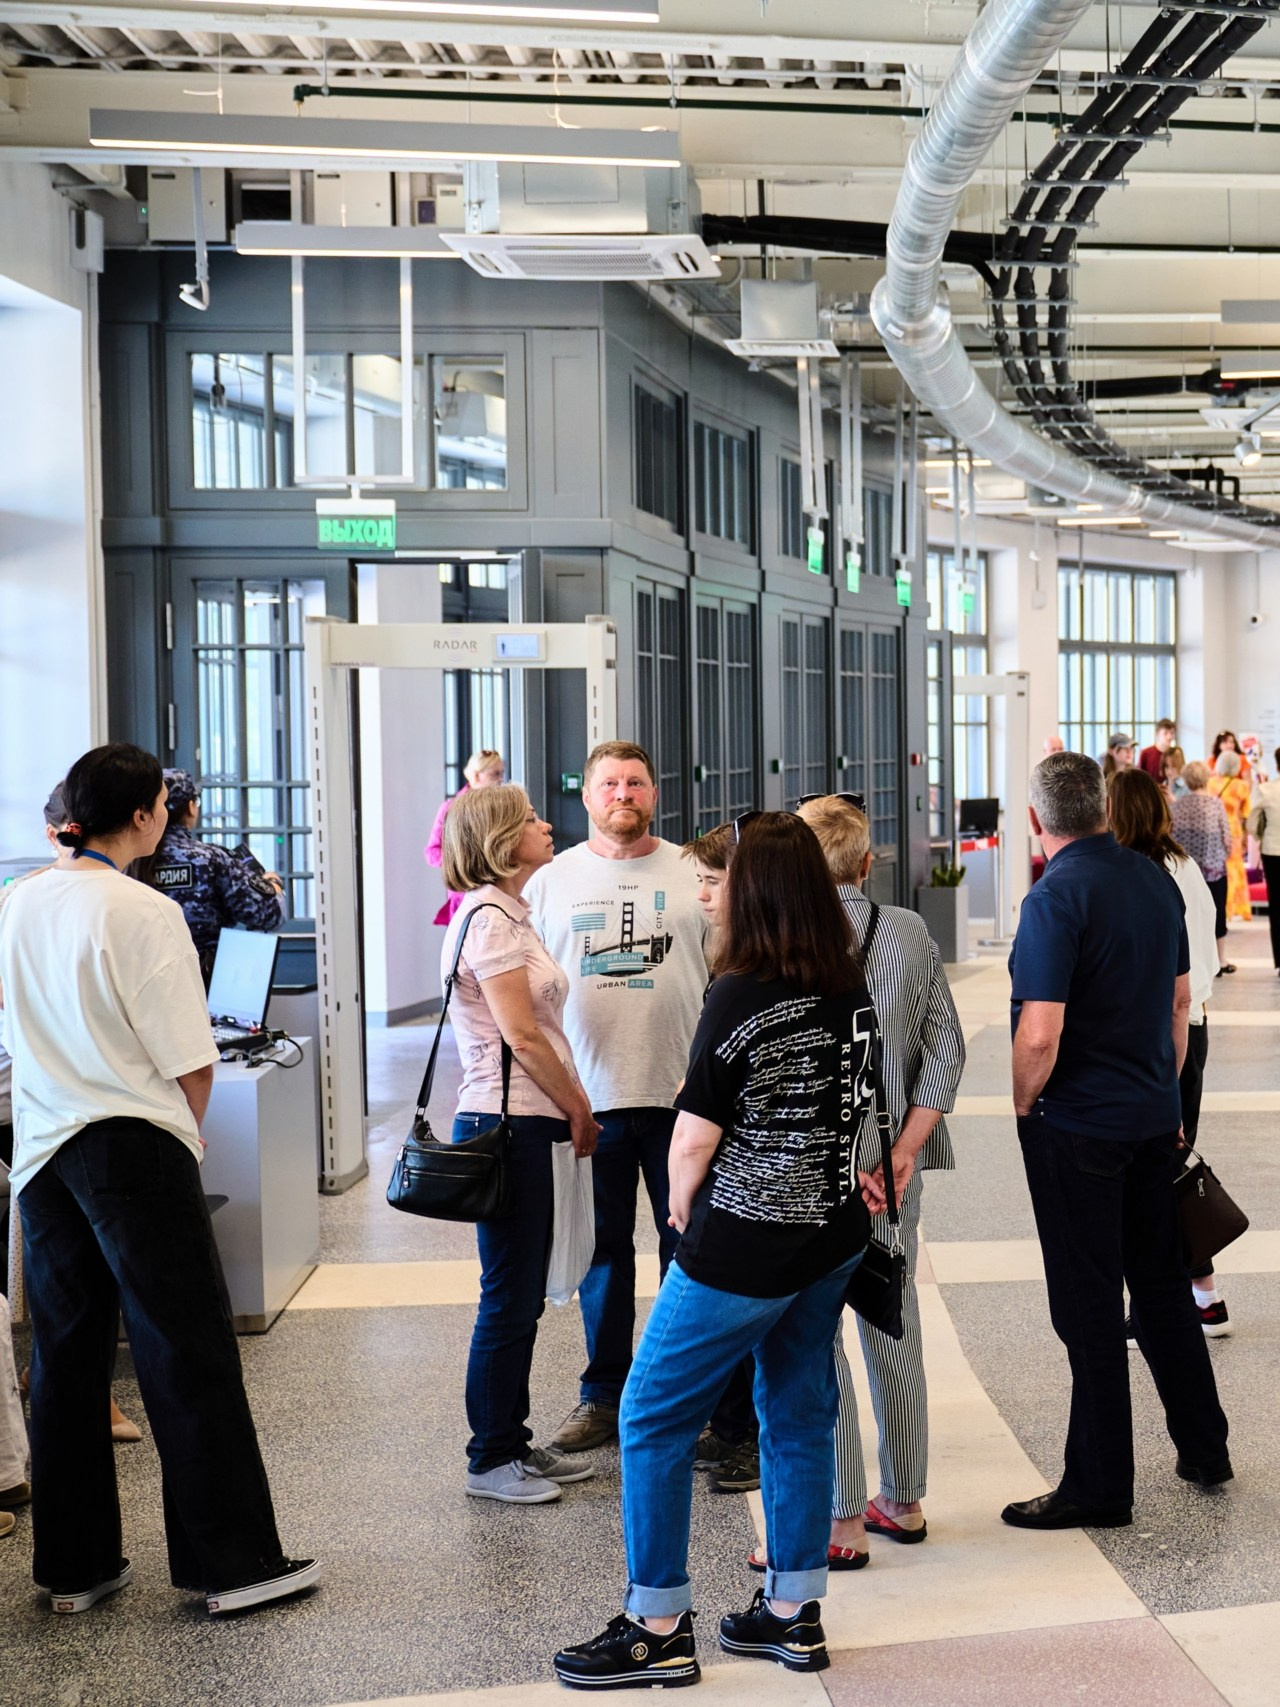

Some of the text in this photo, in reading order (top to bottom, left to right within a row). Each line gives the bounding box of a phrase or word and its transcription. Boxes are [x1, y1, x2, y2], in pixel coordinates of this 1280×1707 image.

[319, 519, 393, 547] ВЫХОД
[433, 639, 477, 650] RADAR
[572, 900, 615, 908] EXPERIENCE
[581, 954, 644, 965] UNDERGROUND
[581, 965, 597, 973] LIFE
[597, 980, 653, 990] URBAN AREA
[841, 1042, 853, 1122] RETRO
